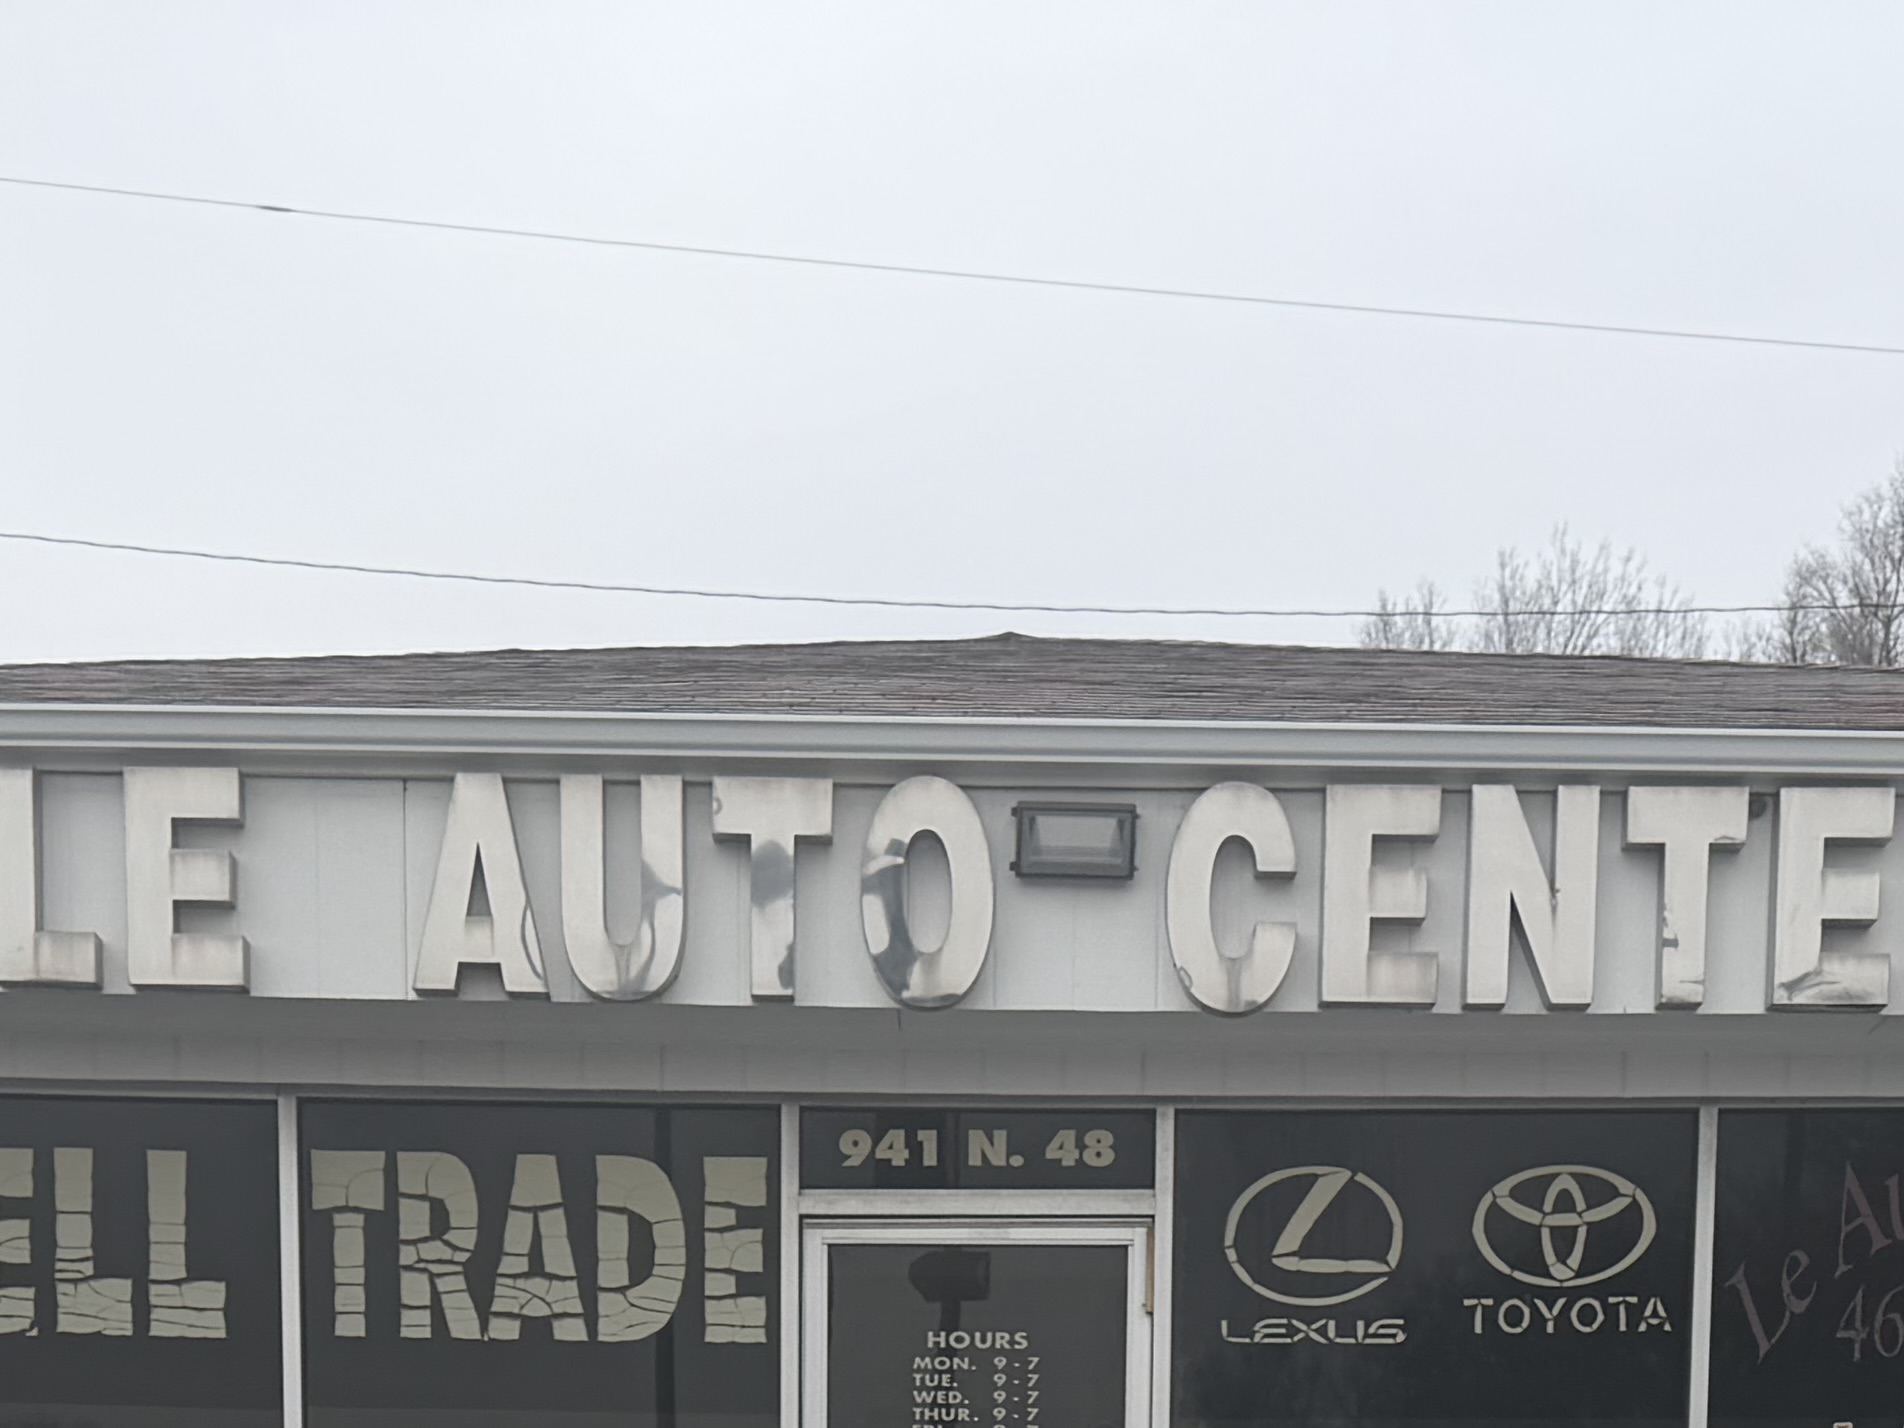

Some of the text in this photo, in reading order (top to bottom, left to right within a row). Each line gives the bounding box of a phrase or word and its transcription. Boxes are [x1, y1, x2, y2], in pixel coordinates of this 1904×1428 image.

[411, 771, 994, 1010] AUTO
[839, 1129, 1115, 1167] 941 N. 48
[311, 1149, 767, 1343] TRADE
[1463, 1297, 1672, 1334] TOYOTA
[1724, 1250, 1817, 1364] Le
[927, 1330, 1029, 1350] HOURS
[1221, 1318, 1407, 1344] LEXUS
[912, 1356, 977, 1371] MON.
[912, 1373, 958, 1388] TUE.
[912, 1390, 970, 1405] WED.
[912, 1407, 979, 1422] THUR.
